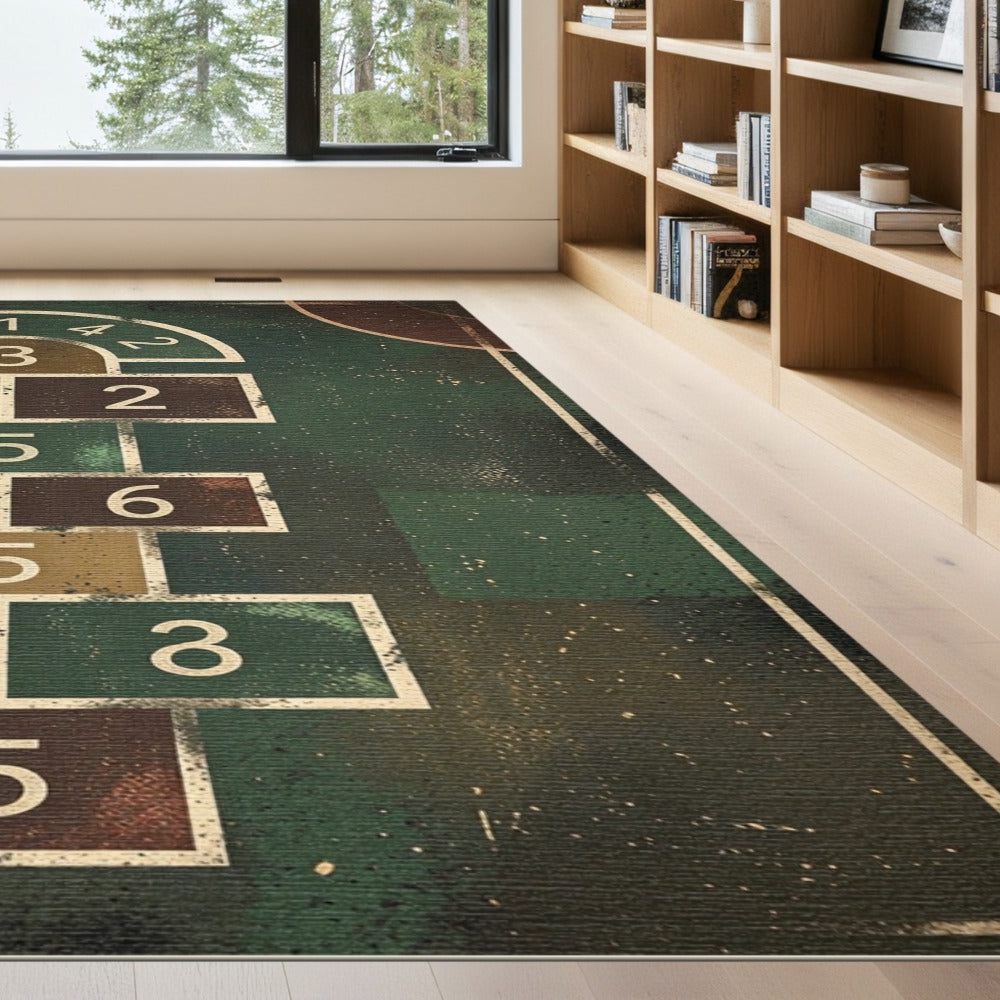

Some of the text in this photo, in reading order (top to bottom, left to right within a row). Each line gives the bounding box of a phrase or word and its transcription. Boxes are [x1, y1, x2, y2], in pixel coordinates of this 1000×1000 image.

[66, 324, 115, 336] 4
[103, 385, 167, 410] 2
[107, 485, 175, 519] 6
